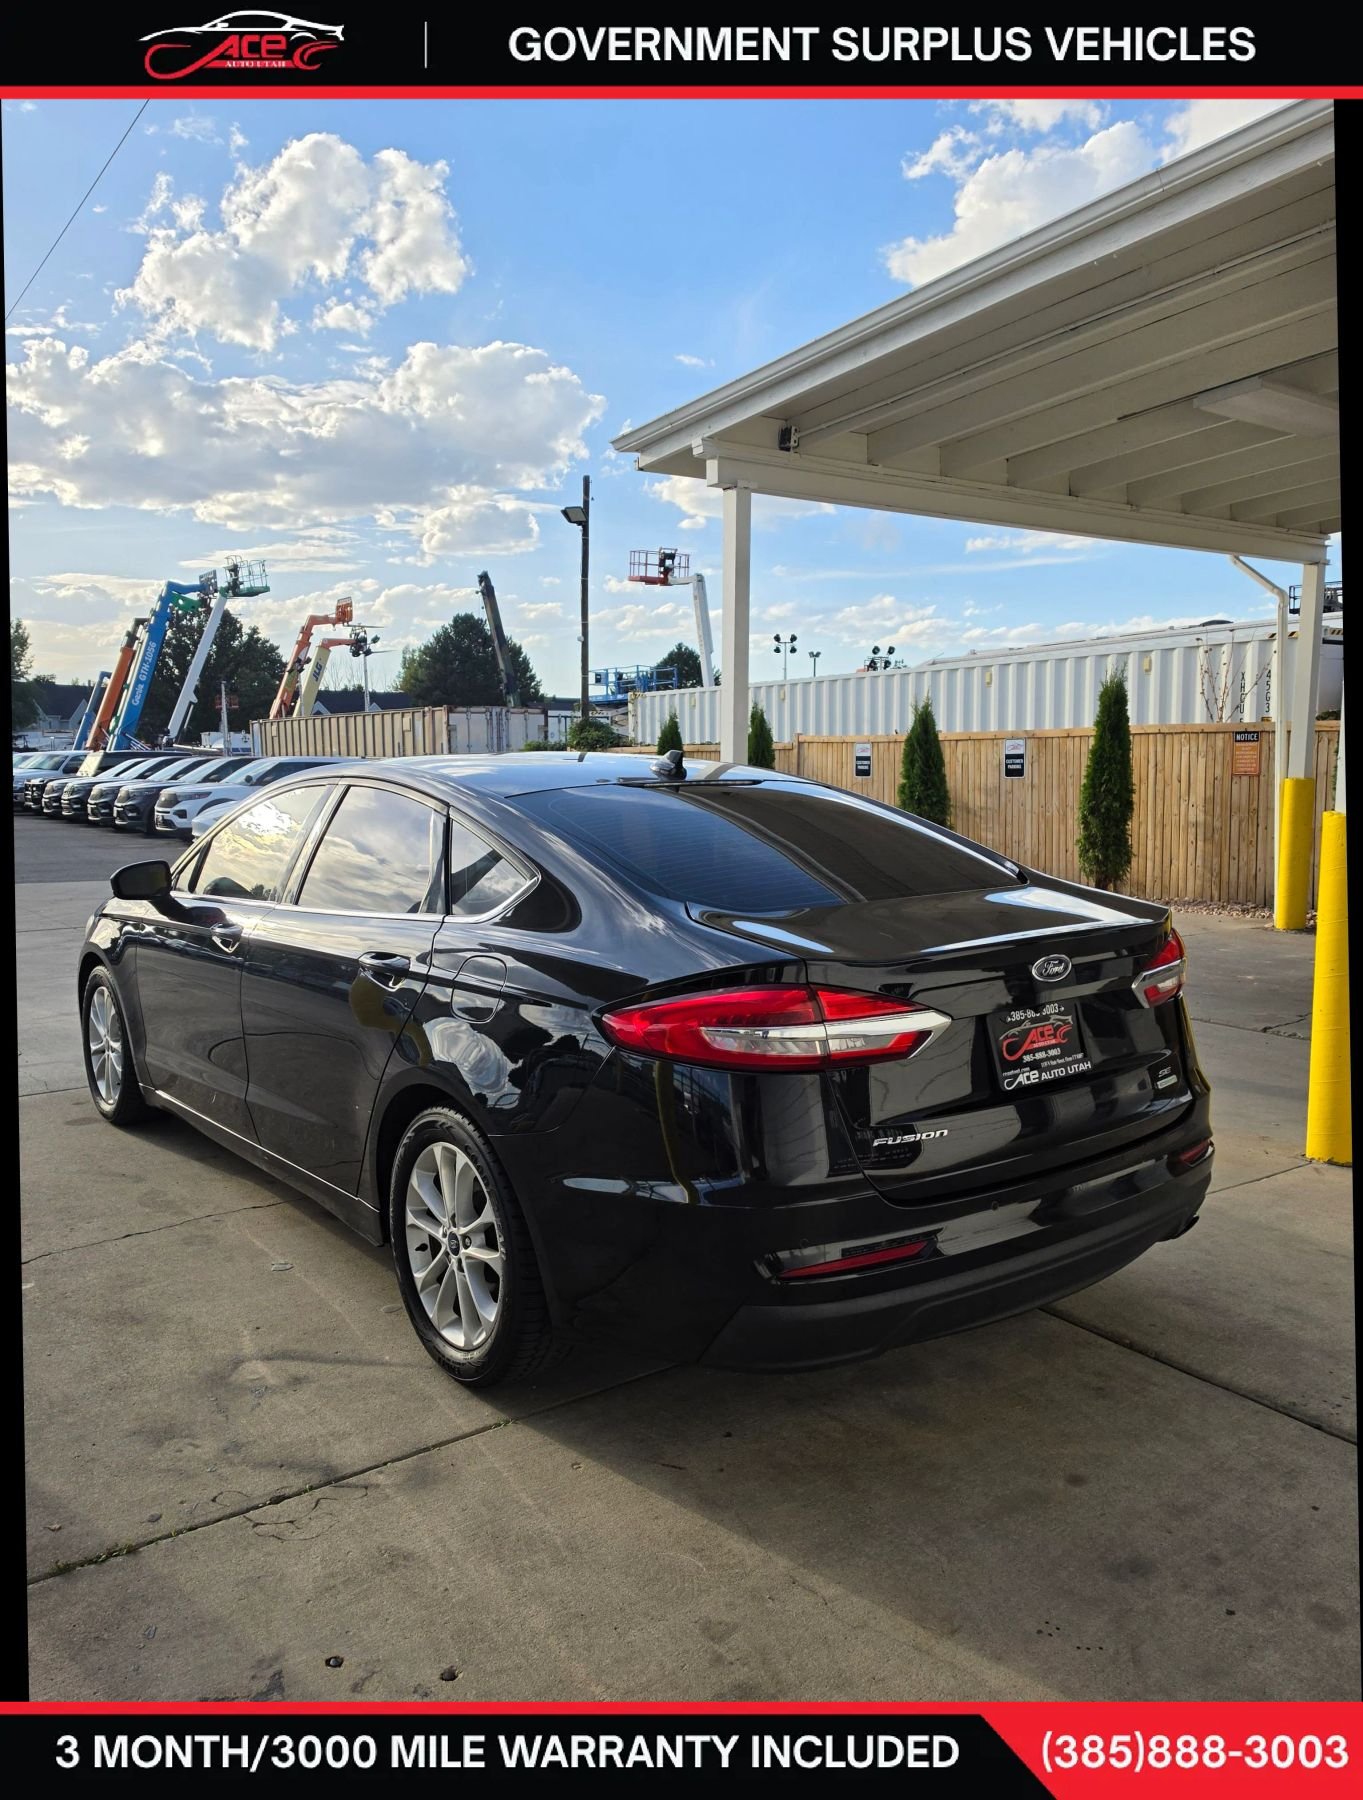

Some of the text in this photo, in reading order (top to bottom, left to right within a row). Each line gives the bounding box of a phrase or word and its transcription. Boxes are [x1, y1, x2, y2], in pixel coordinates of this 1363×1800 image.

[139, 640, 157, 681] GTH-1056
[312, 662, 323, 682] JLG
[1236, 733, 1258, 741] NOTICE
[1042, 960, 1064, 976] Ford
[1010, 1003, 1059, 1022] 385-883003
[1041, 1067, 1066, 1080] AUTO
[1067, 1061, 1092, 1074] UTAH
[872, 1129, 949, 1147] FUSION
